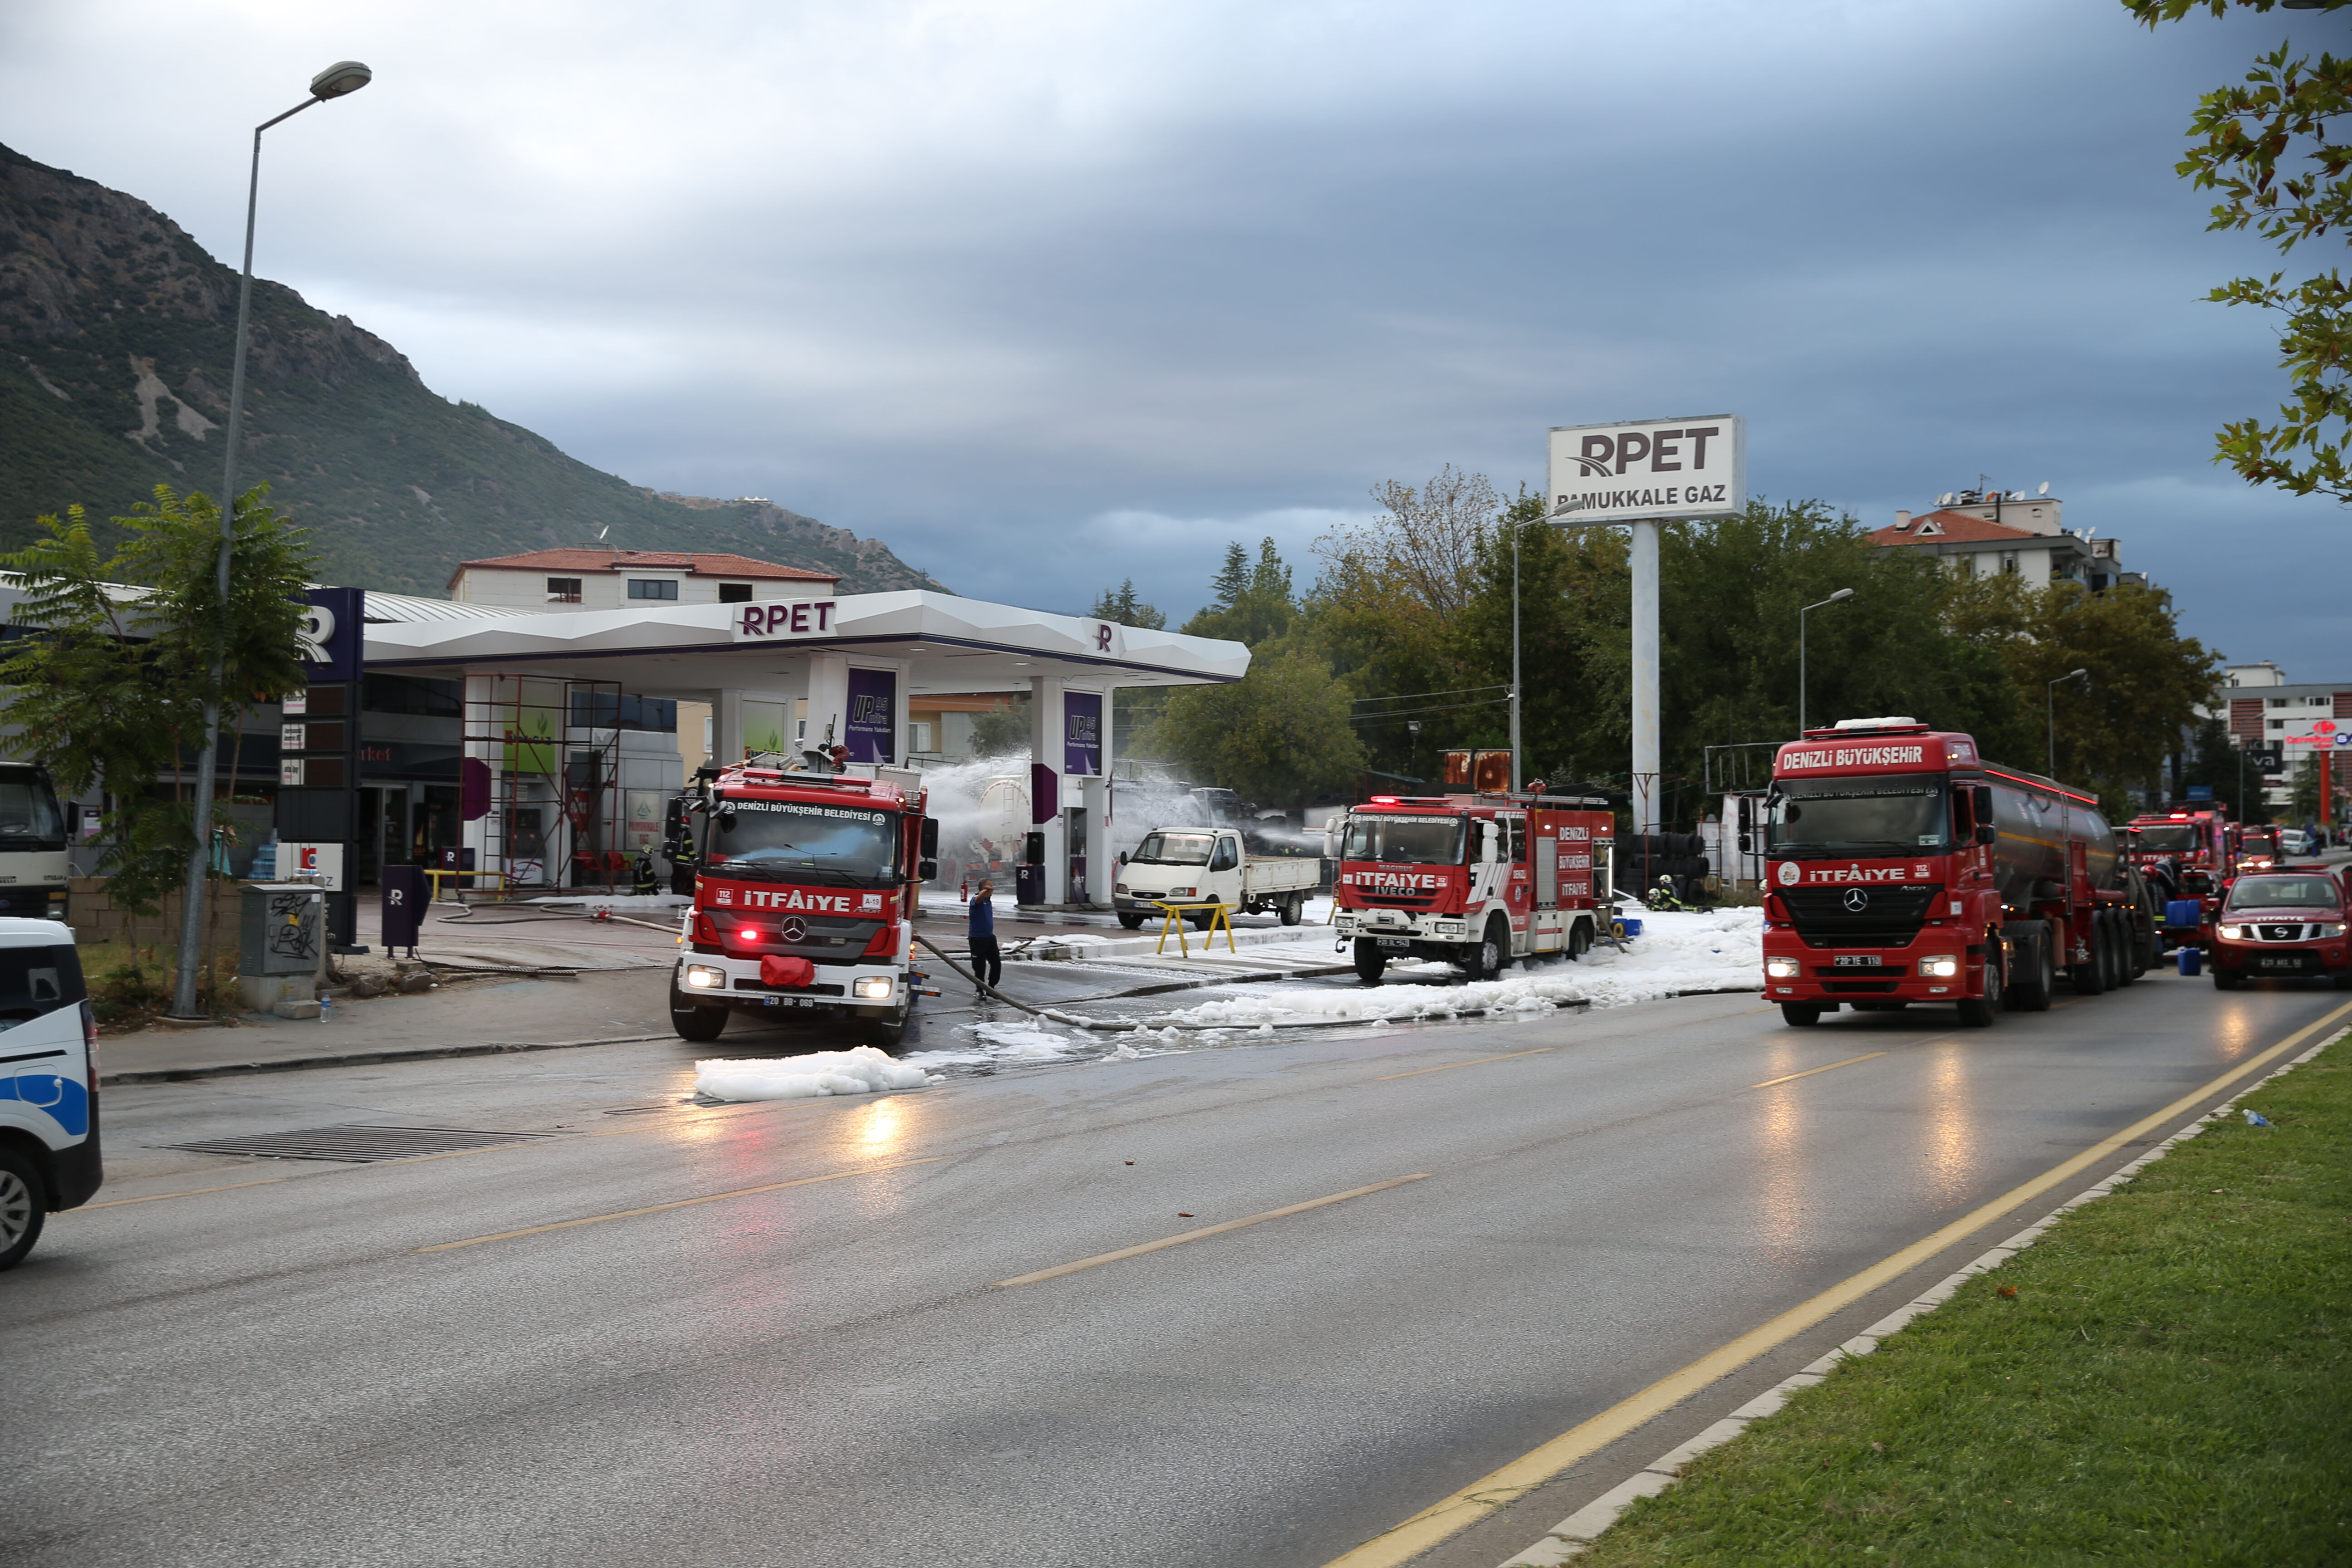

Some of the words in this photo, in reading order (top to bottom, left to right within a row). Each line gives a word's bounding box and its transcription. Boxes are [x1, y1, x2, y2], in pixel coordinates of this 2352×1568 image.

[1564, 427, 1719, 477] RPET
[1685, 485, 1725, 504] GAZ
[735, 602, 835, 635] RPET
[294, 605, 335, 663] R
[1093, 624, 1112, 652] R
[853, 695, 874, 723] UP
[876, 697, 888, 711] 95
[868, 713, 887, 724] ultra
[1069, 715, 1085, 740] UP
[356, 747, 392, 762] rket
[1916, 864, 1927, 872] 112
[387, 889, 403, 906] R
[719, 890, 730, 899] 112
[1375, 886, 1416, 897] IVECO
[784, 998, 793, 1006] BB
[799, 999, 813, 1007] 069
